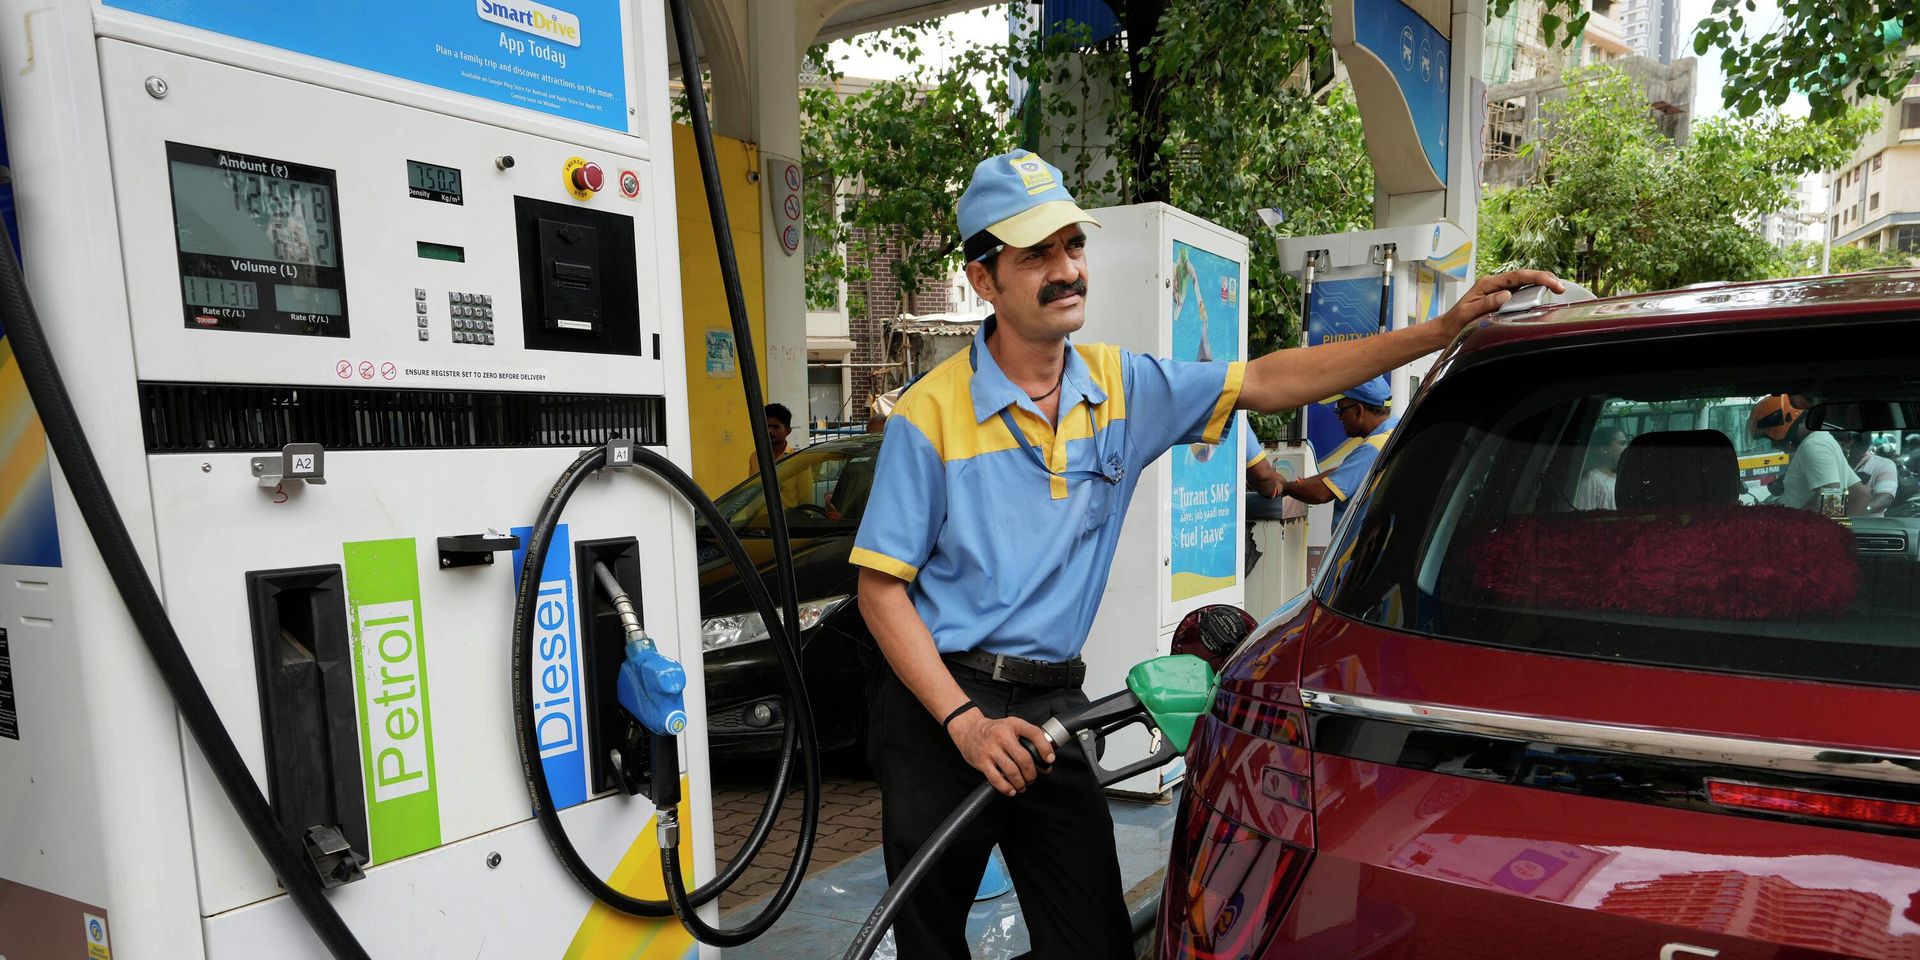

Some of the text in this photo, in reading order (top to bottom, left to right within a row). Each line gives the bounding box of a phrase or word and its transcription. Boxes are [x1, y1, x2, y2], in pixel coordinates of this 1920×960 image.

[482, 0, 577, 39] SmartDrive
[499, 32, 566, 68] App Today
[435, 44, 451, 56] Plan
[460, 51, 483, 67] family
[484, 58, 497, 71] trip
[499, 62, 512, 73] and
[513, 65, 540, 79] discover
[541, 74, 576, 90] attractions
[577, 83, 585, 92] on
[585, 84, 597, 95] the
[532, 88, 549, 98] Android
[220, 155, 289, 179] Amount (₹)
[416, 165, 456, 193] 750.2
[409, 189, 430, 199] Density
[574, 190, 587, 198] STOP
[231, 259, 277, 275] Volume
[202, 307, 220, 316] Rate
[290, 313, 307, 322] Rate
[405, 369, 430, 377] ENSURE
[431, 370, 461, 378] REGISTER
[295, 458, 312, 469] A2
[616, 450, 627, 460] A1
[1211, 483, 1230, 503] SMS
[1181, 526, 1198, 548] fuel
[535, 587, 573, 751] Diesel
[364, 615, 423, 787] Petrol
